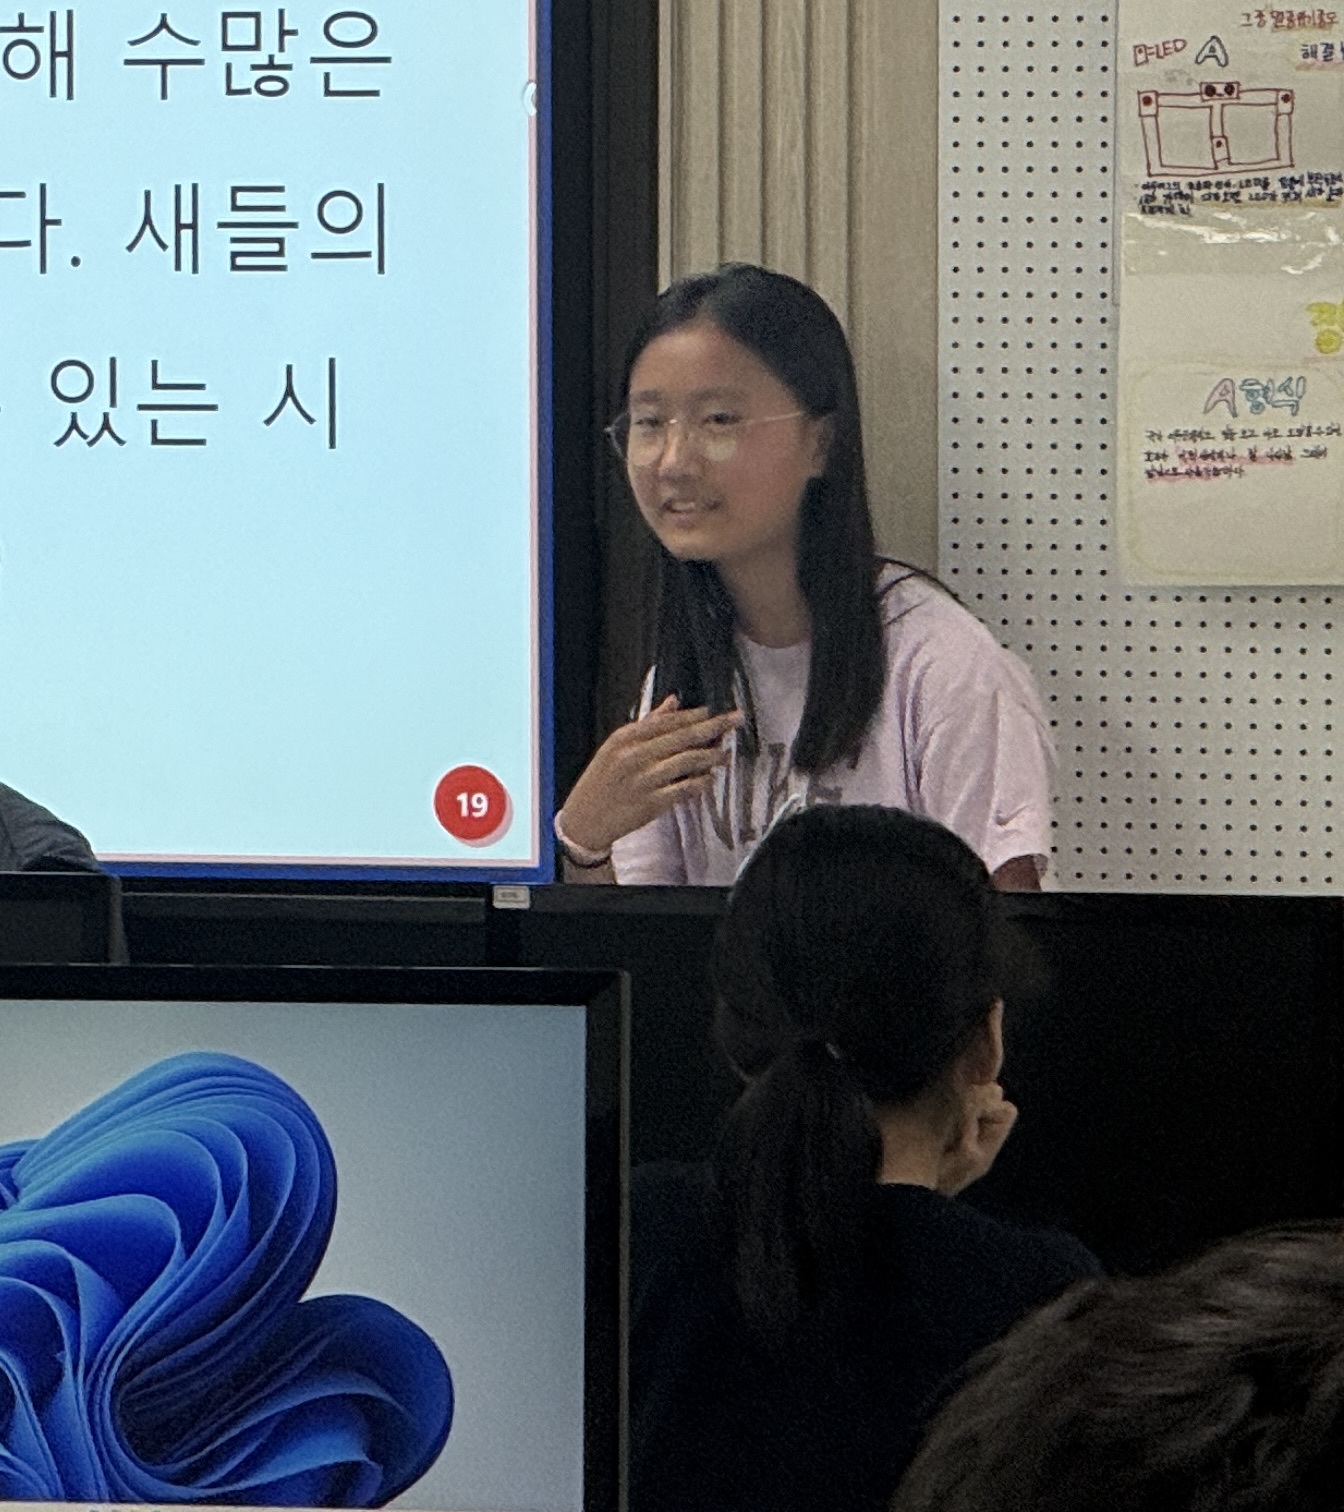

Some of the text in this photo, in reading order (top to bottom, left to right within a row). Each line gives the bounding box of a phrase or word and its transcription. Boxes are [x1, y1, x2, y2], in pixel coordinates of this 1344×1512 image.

[123, 8, 393, 100] 수많은
[126, 182, 387, 275] 새들의
[49, 356, 220, 448] 있는
[262, 357, 341, 450] 시
[457, 792, 490, 818] 19
